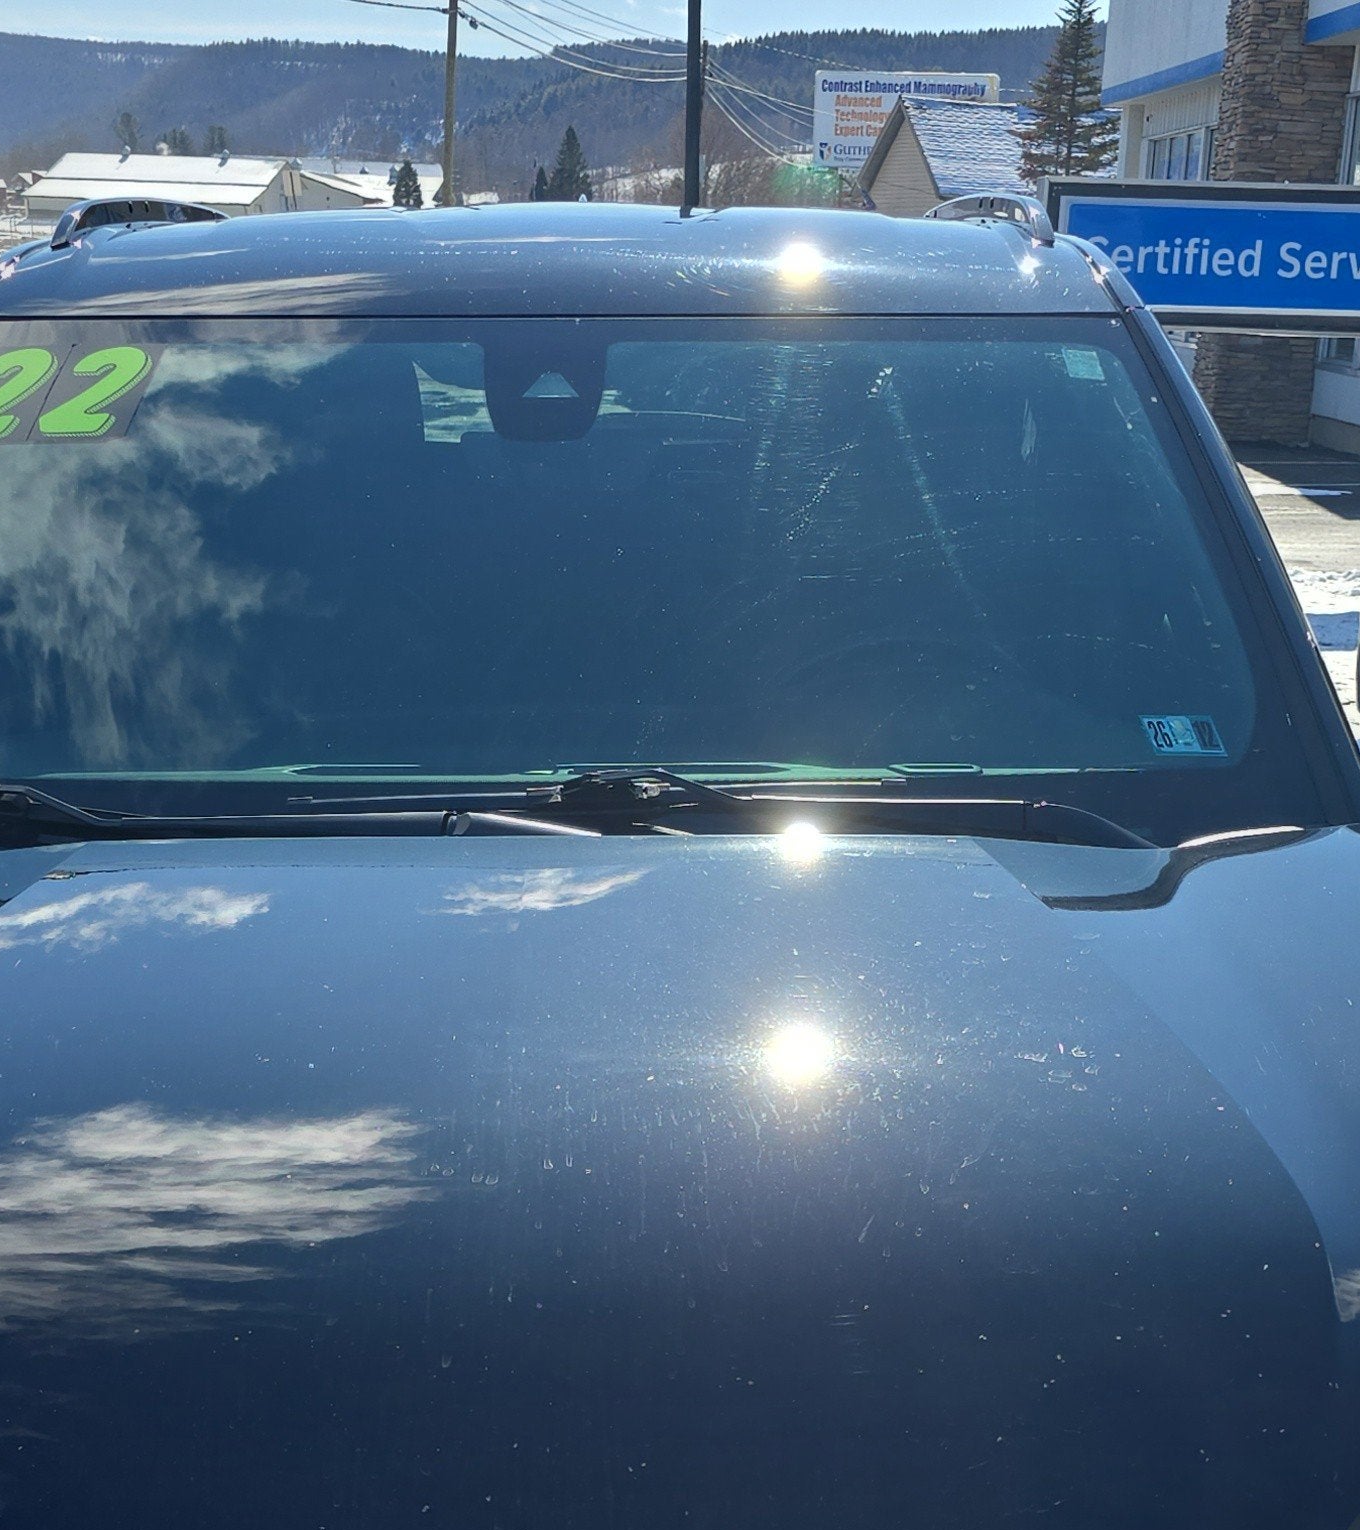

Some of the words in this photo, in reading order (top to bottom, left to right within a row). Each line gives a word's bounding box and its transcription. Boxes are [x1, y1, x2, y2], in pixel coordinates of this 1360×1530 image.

[821, 79, 863, 93] Contrast
[865, 80, 911, 94] Enhanced
[913, 81, 987, 97] Mammography
[835, 94, 882, 107] Advanced
[835, 124, 864, 137] Expert
[1146, 720, 1174, 748] 26
